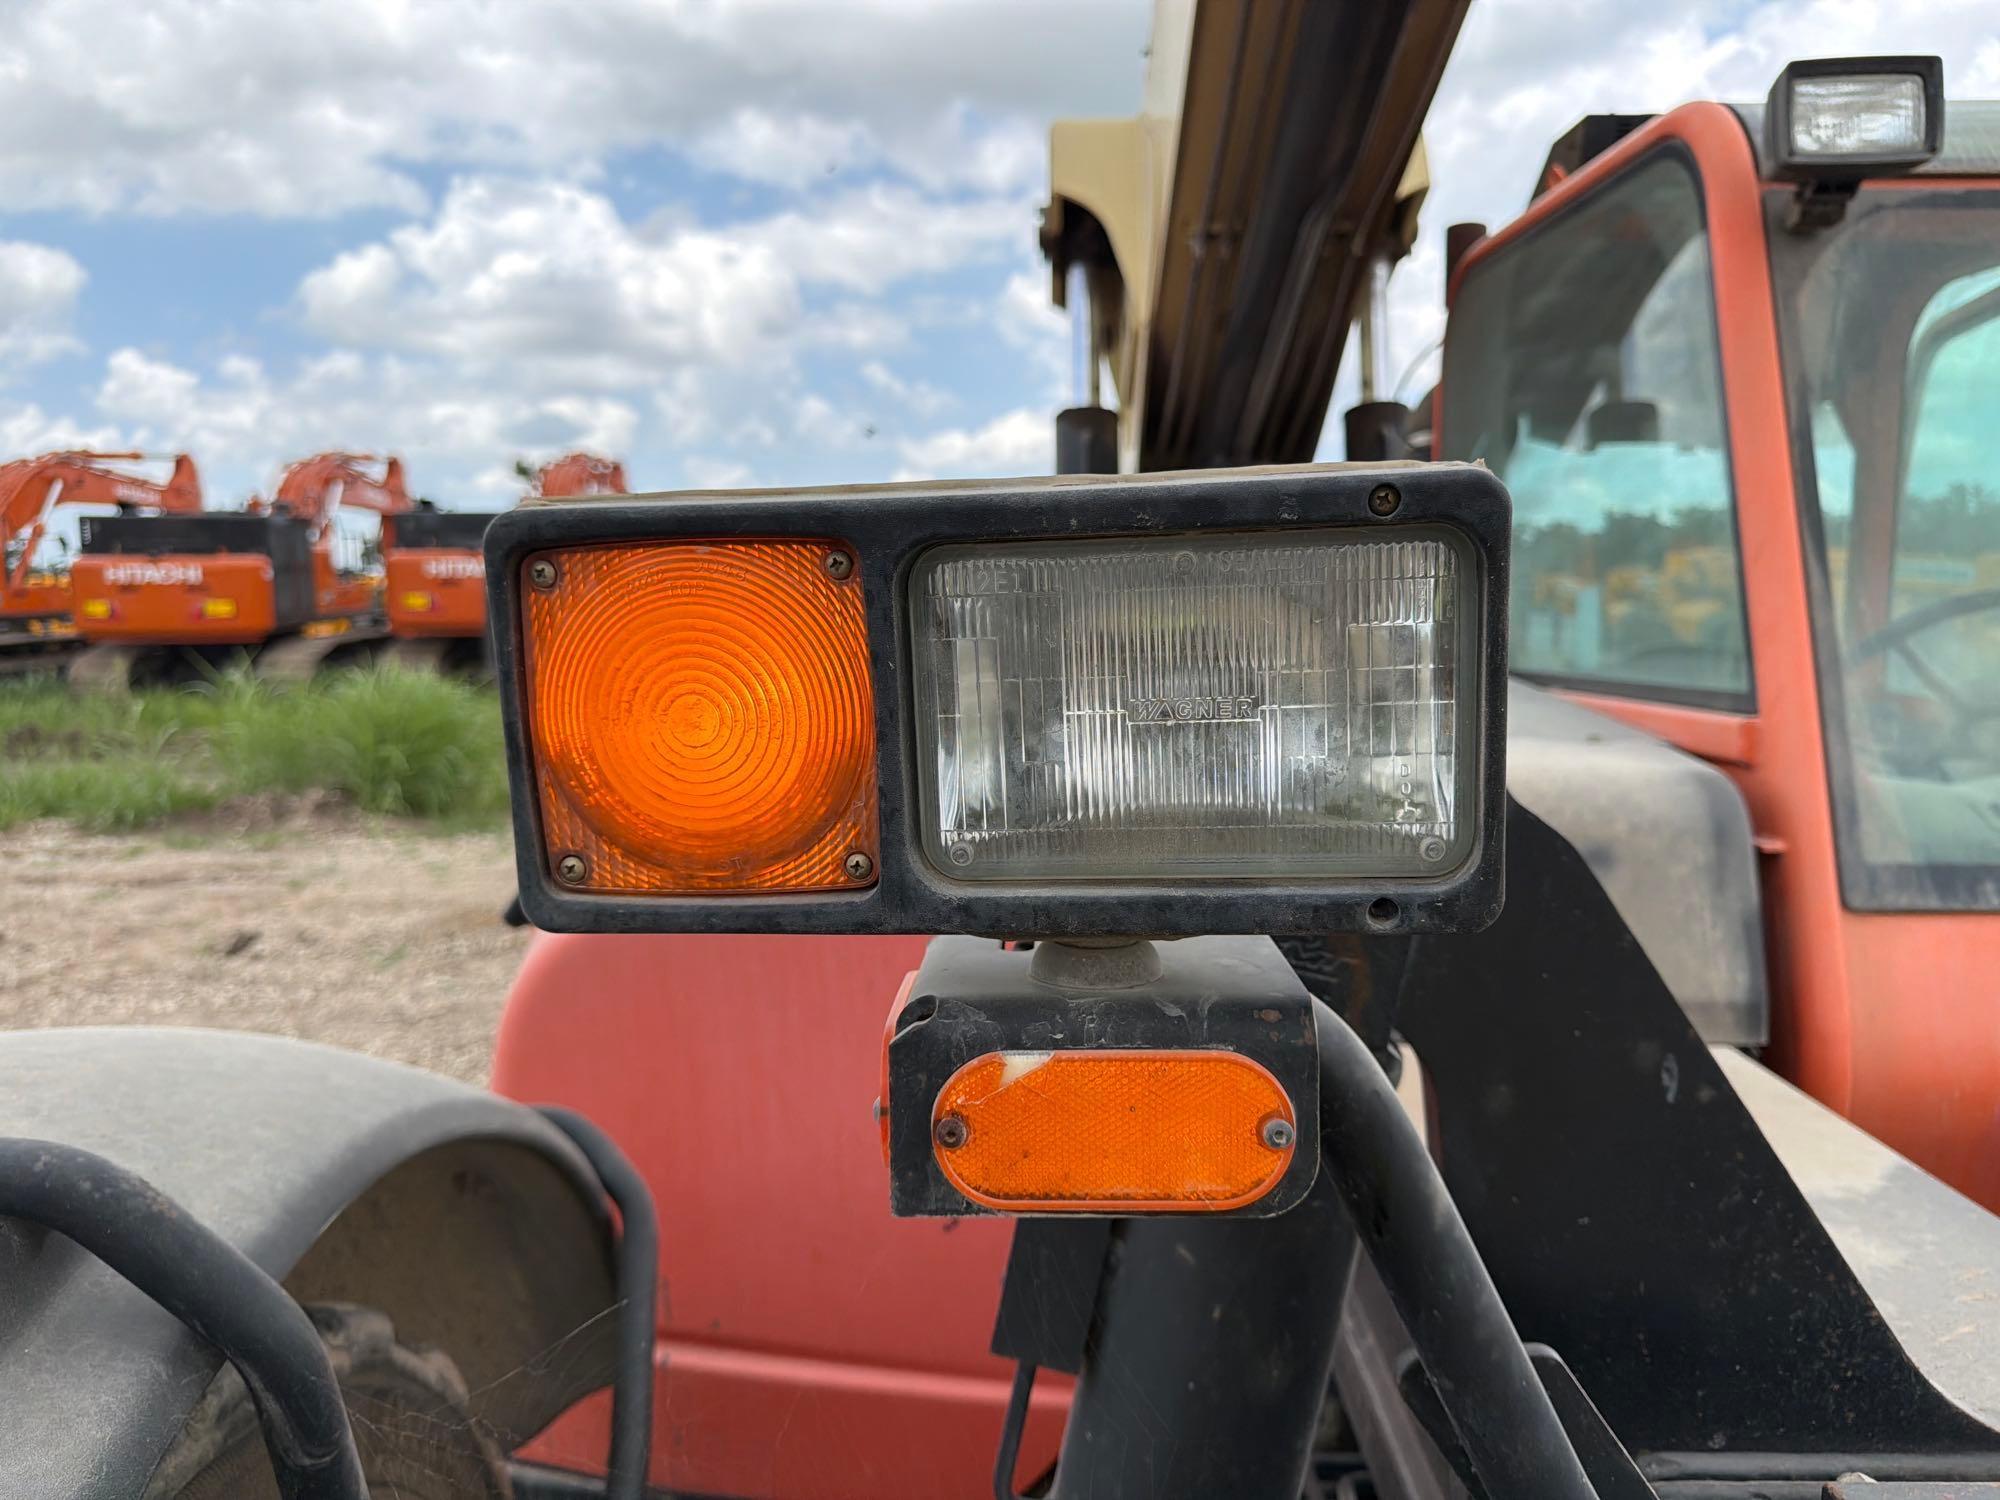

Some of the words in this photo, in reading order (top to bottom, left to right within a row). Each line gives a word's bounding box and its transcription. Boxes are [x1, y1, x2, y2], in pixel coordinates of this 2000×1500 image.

[103, 563, 203, 585] HITACHI
[422, 558, 484, 578] HITA
[1133, 699, 1253, 721] WAGNER
